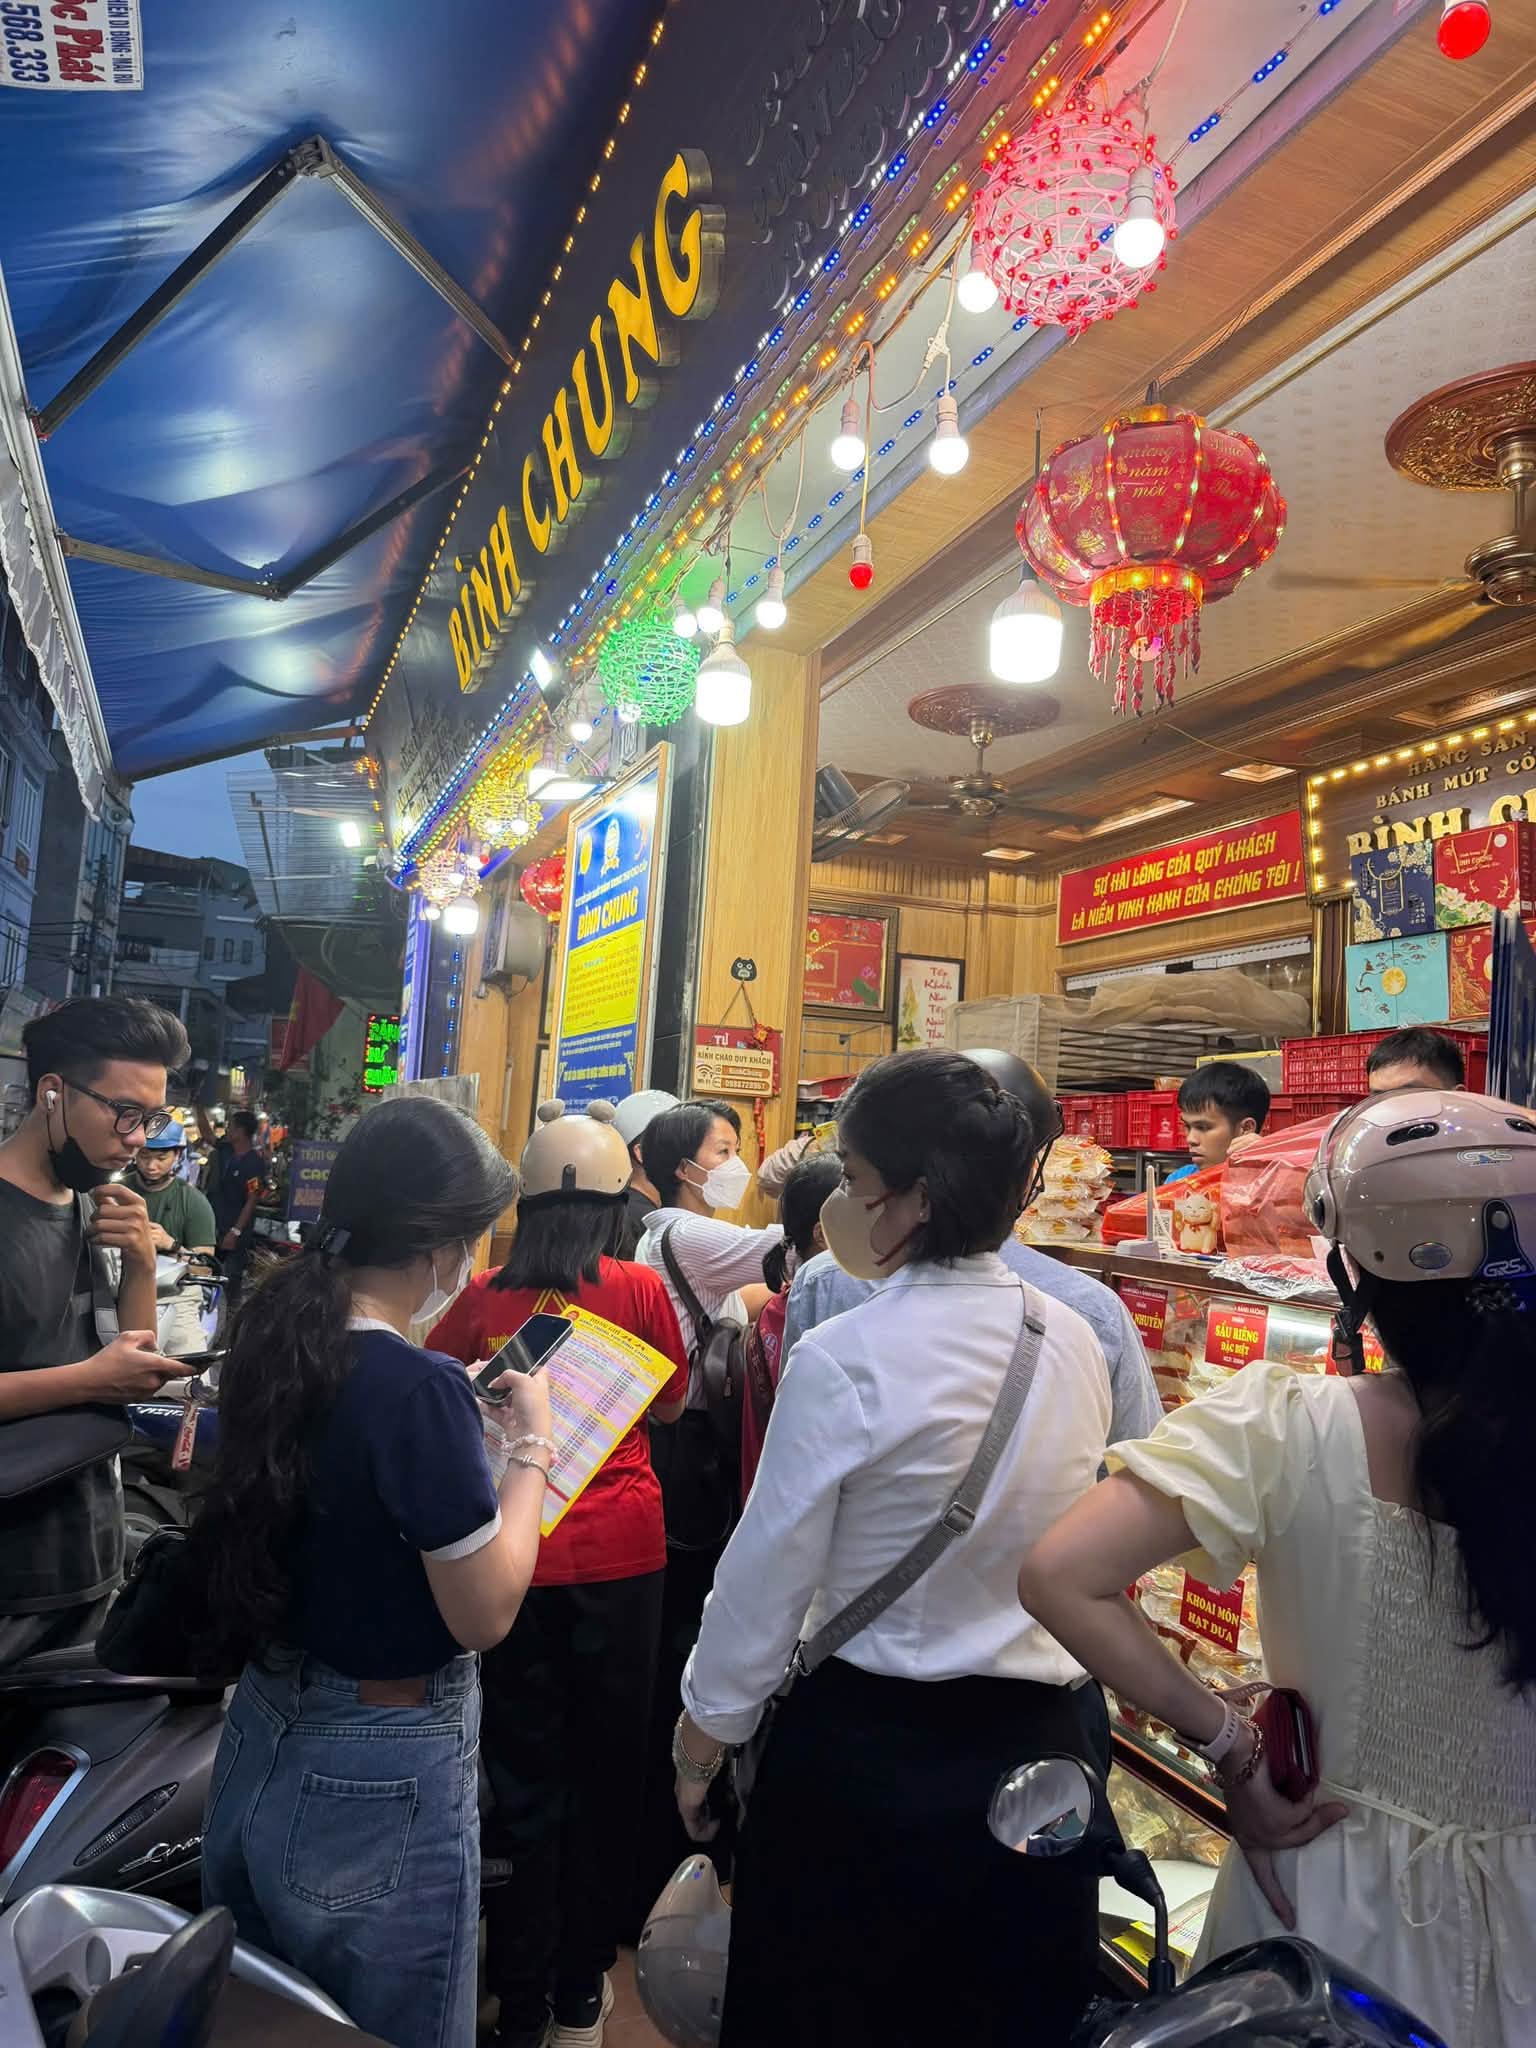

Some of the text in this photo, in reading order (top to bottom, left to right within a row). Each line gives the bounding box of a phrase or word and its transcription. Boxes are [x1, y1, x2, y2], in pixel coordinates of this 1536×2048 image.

[0, 2, 50, 83] 568.333
[53, 25, 106, 83] Phát
[447, 153, 703, 693] BÌNH CHUNG
[1375, 782, 1431, 809] BÁNH
[1443, 765, 1490, 791] MỨT
[1093, 831, 1278, 898] SỰ HÀI LÒNG CỦA QUÝ KHÁCH
[576, 886, 639, 941] BÌNH CHUNG
[1071, 902, 1086, 931] LÀ
[1087, 901, 1115, 928] NIỀM
[1117, 896, 1145, 921] VINH
[1146, 892, 1182, 917] HẠNH
[1184, 879, 1210, 907] CỦA
[1213, 869, 1263, 901] CHÚNG
[1265, 861, 1291, 889] TÔI
[1483, 1258, 1521, 1277] GRS
[1233, 1326, 1259, 1344] RIÊNG
[1186, 1591, 1240, 1626] KHOAI MÔN
[1188, 1611, 1209, 1630] HẠT
